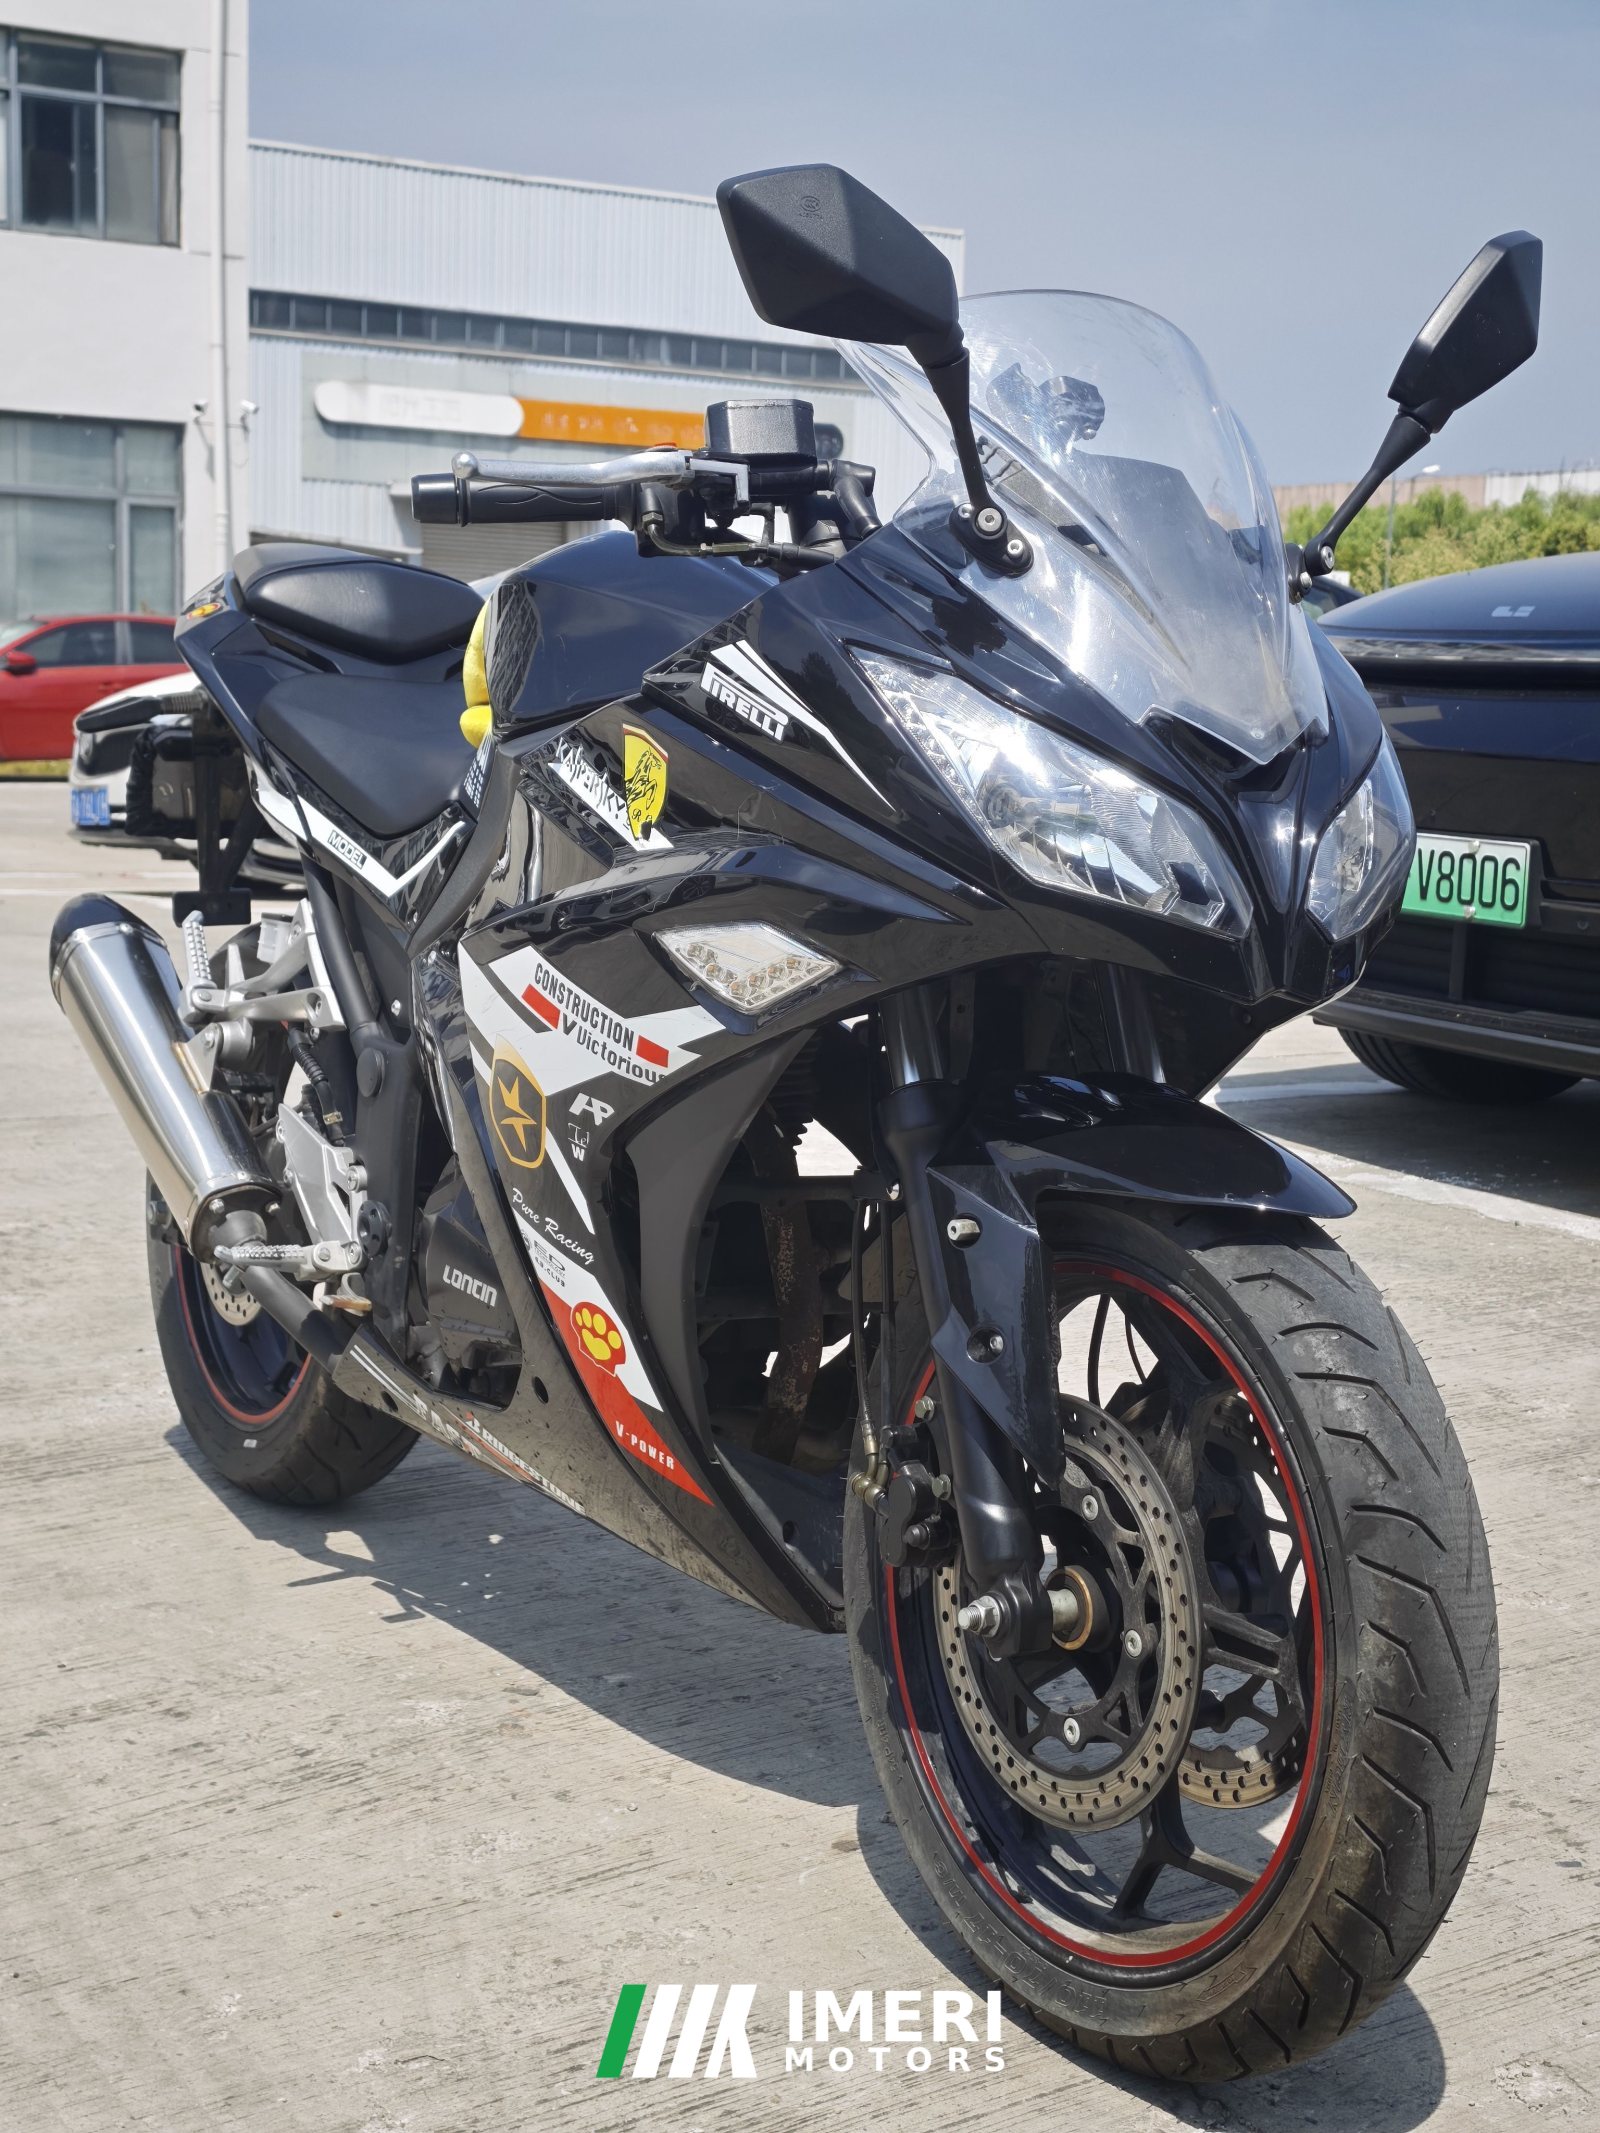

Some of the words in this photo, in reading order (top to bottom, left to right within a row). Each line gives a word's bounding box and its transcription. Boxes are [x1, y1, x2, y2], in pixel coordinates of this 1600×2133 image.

[701, 661, 789, 741] PIRELLI
[328, 830, 367, 870] MODEL
[1418, 848, 1521, 911] V8006
[534, 962, 635, 1052] CONSTRUCTION
[512, 1187, 540, 1223] Pure
[544, 1217, 595, 1265] Racing
[615, 1420, 675, 1470] V-POWER
